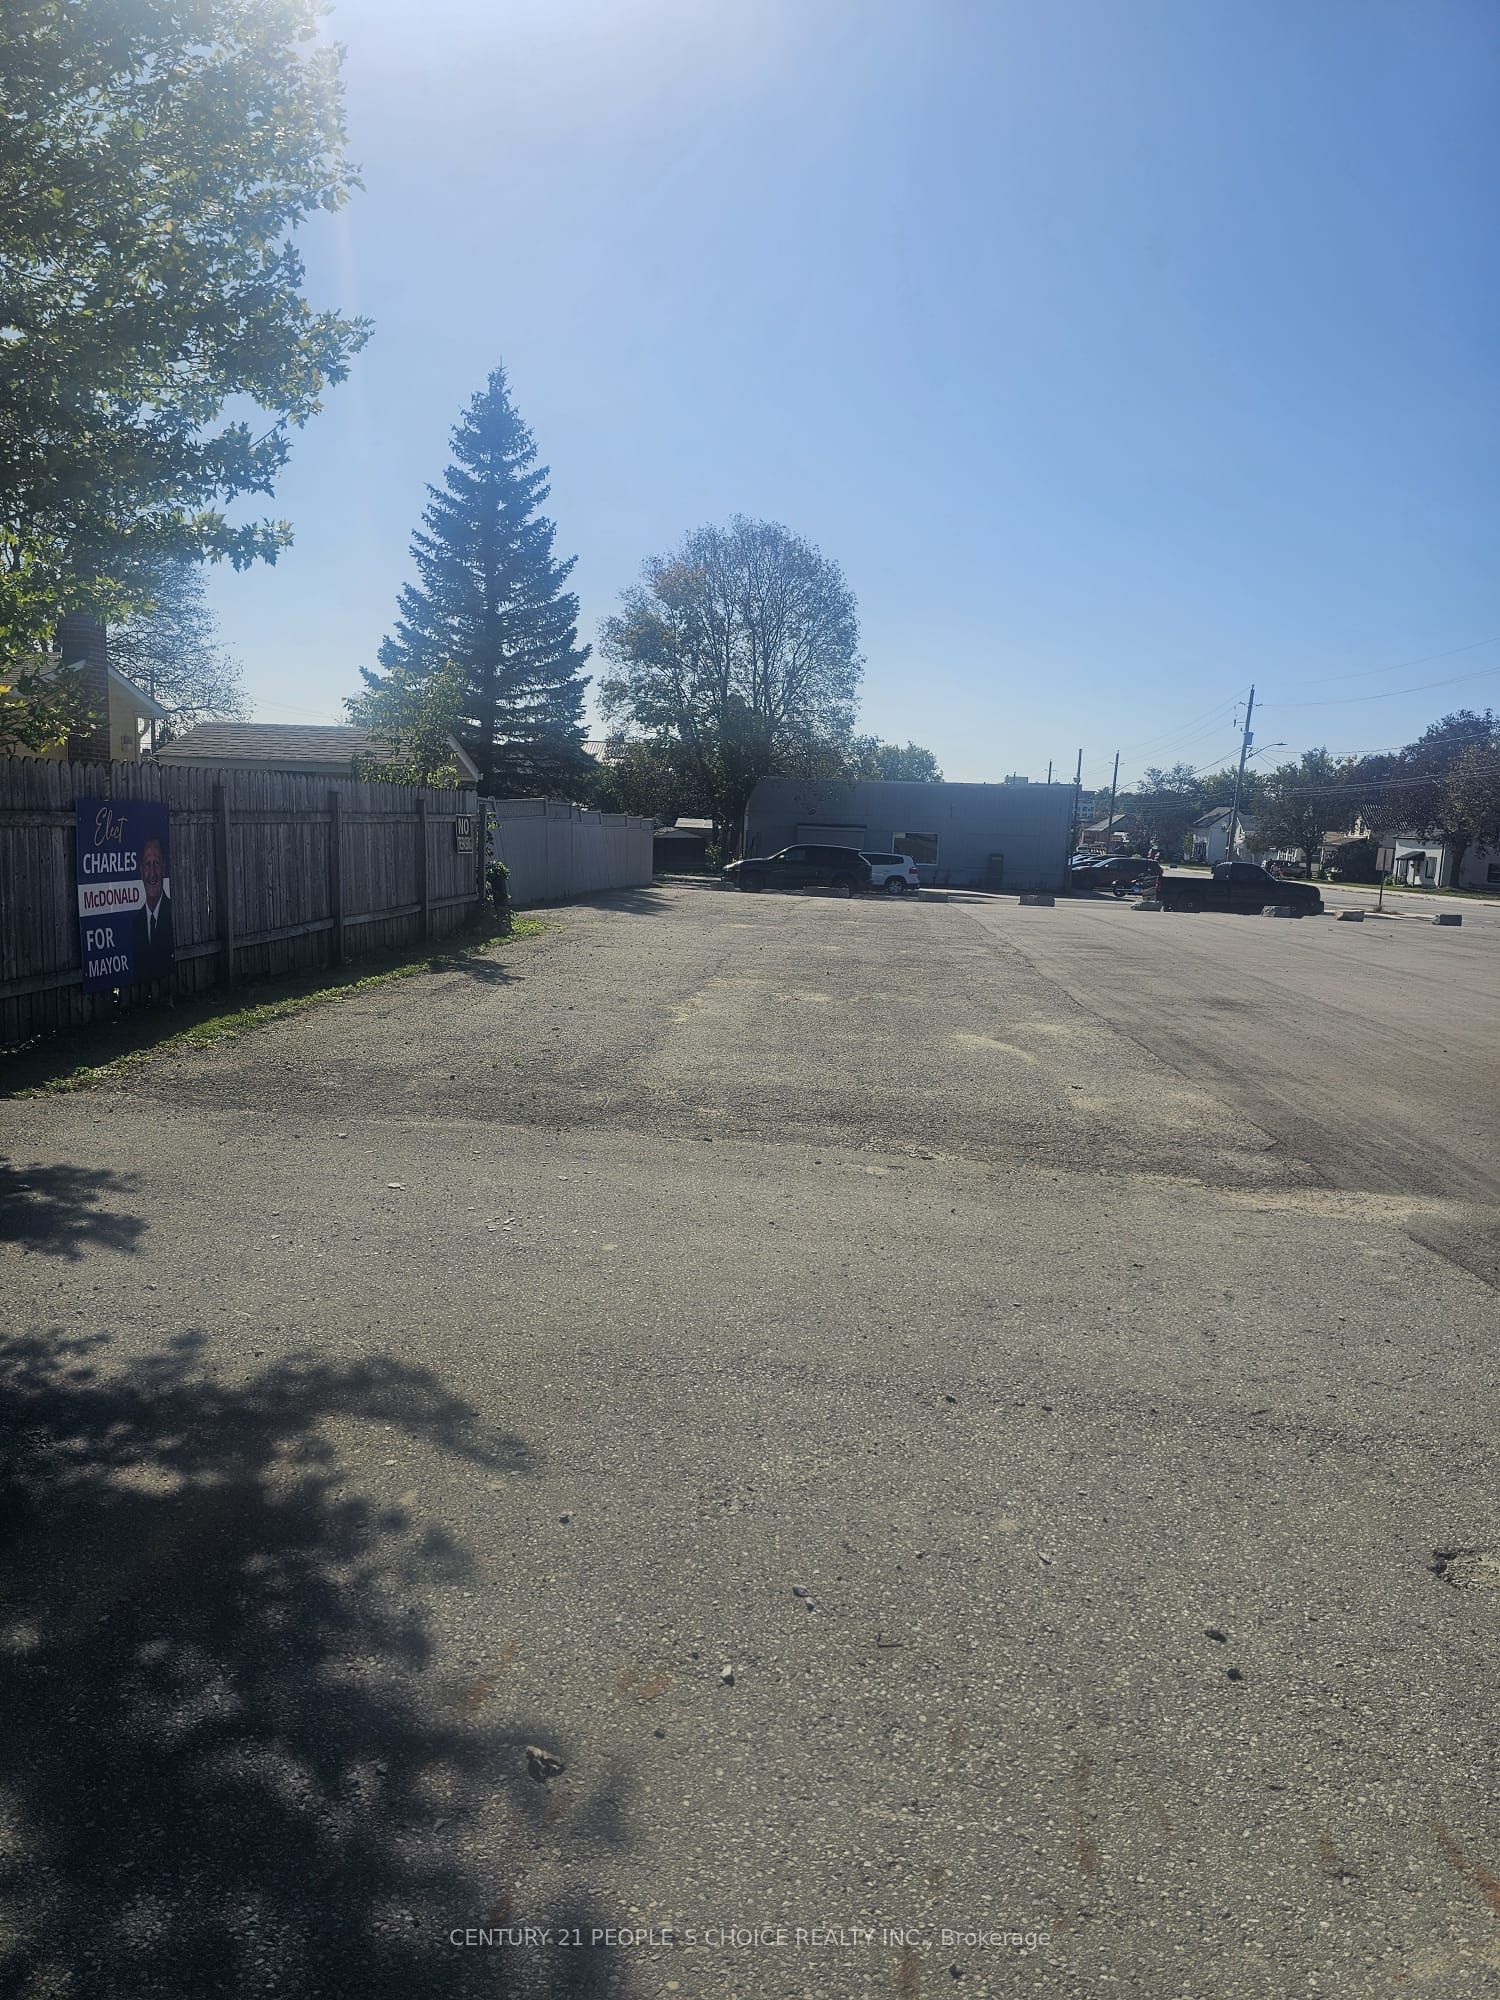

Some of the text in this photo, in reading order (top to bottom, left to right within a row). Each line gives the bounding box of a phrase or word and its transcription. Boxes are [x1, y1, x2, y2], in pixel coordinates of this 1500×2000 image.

[94, 807, 128, 846] Elect
[458, 817, 470, 835] NO
[83, 852, 137, 874] CHARLES
[83, 887, 140, 909] McDONALD
[86, 927, 115, 951] FOR
[88, 954, 129, 978] MAYOR
